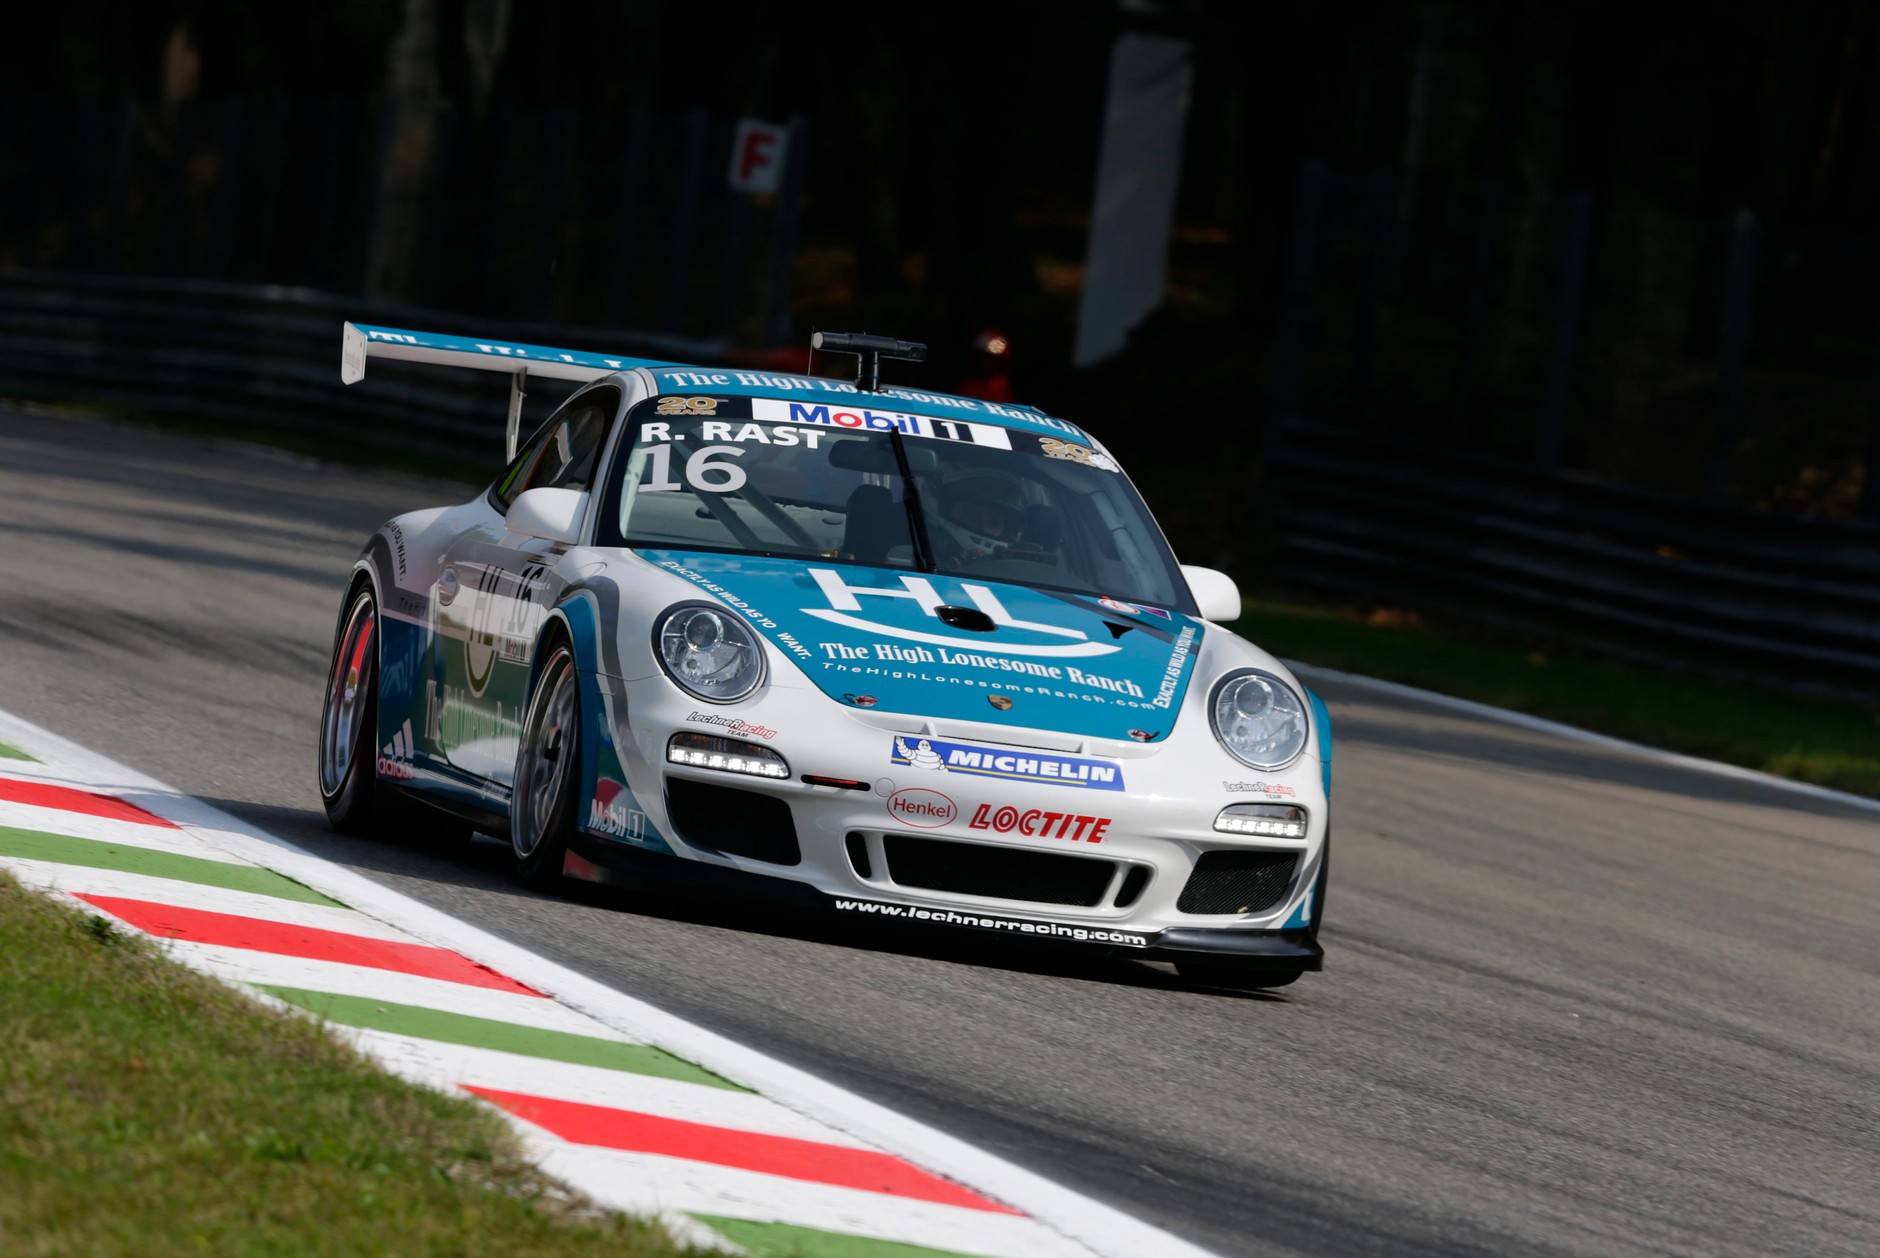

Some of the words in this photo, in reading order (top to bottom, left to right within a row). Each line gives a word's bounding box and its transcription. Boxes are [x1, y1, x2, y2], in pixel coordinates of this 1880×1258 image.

[741, 131, 778, 180] F
[657, 397, 718, 411] 20
[664, 372, 730, 387] The
[738, 373, 816, 391] High
[981, 401, 1085, 438] Ranch
[789, 403, 921, 435] Mobil
[940, 421, 961, 441] 1
[641, 422, 685, 443] R.
[703, 421, 826, 449] RAST
[1038, 437, 1091, 459] 20
[638, 444, 747, 493] 16
[661, 561, 708, 587] EXACTLY
[702, 583, 723, 596] AS
[719, 591, 748, 610] WILD
[742, 608, 764, 620] AS
[776, 632, 812, 660] WANT.
[808, 568, 1088, 640] HL
[819, 642, 870, 660] The
[874, 644, 934, 665] High
[940, 649, 1063, 681] Lonesome
[1065, 666, 1146, 699] Ranch
[822, 662, 1156, 710] TheHighLonesomeRanch.com
[1153, 676, 1178, 709] EXACTLY
[727, 730, 748, 738] TEAM
[378, 757, 414, 779] adidas
[949, 750, 1115, 782] MICHELIN
[588, 798, 627, 837] Mobil
[893, 798, 951, 819] Henkel
[969, 803, 1112, 844] LOCTITE
[835, 899, 1147, 946] www.lechnerracing.com
